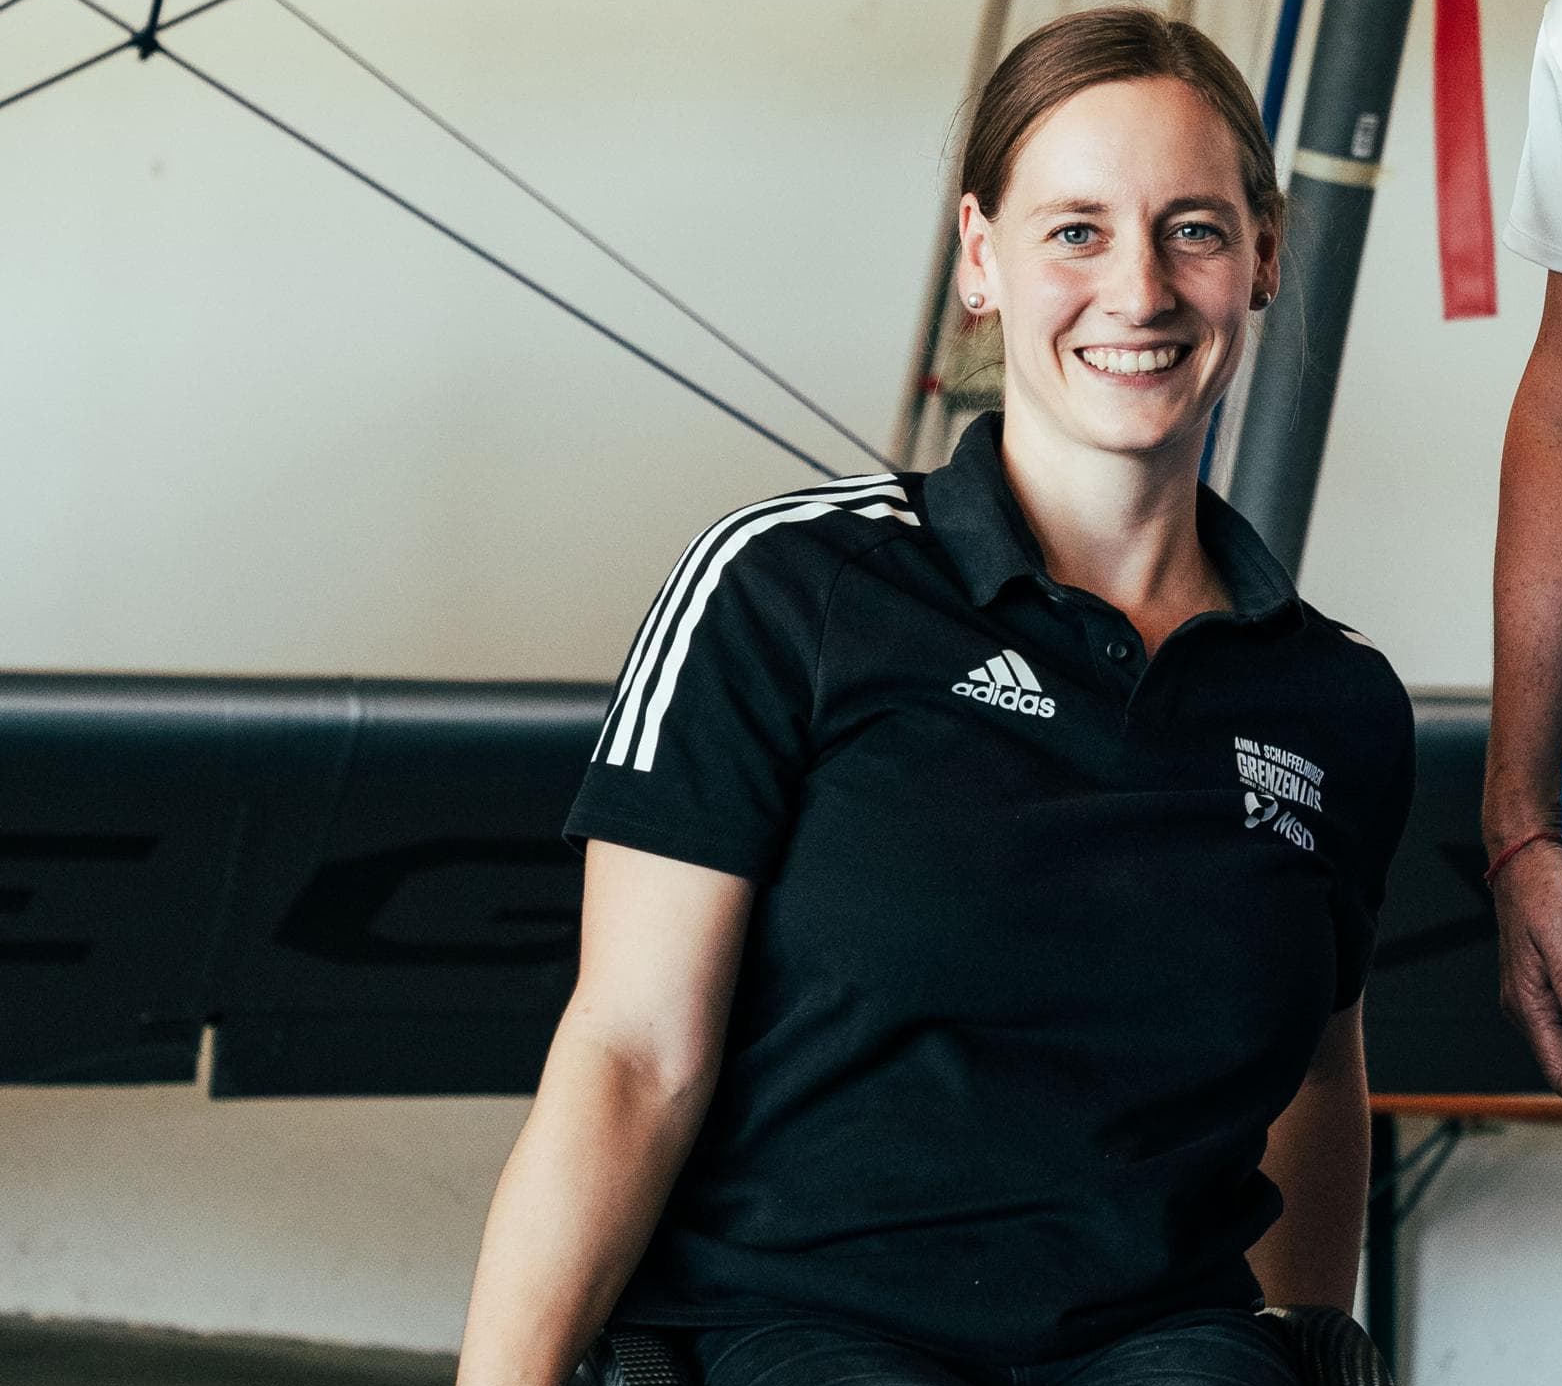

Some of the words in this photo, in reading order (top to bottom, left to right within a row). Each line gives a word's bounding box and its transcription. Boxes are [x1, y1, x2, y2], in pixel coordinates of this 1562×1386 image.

[951, 682, 1056, 719] adidas
[1234, 736, 1261, 757] ANNA
[1272, 811, 1315, 852] MSD
